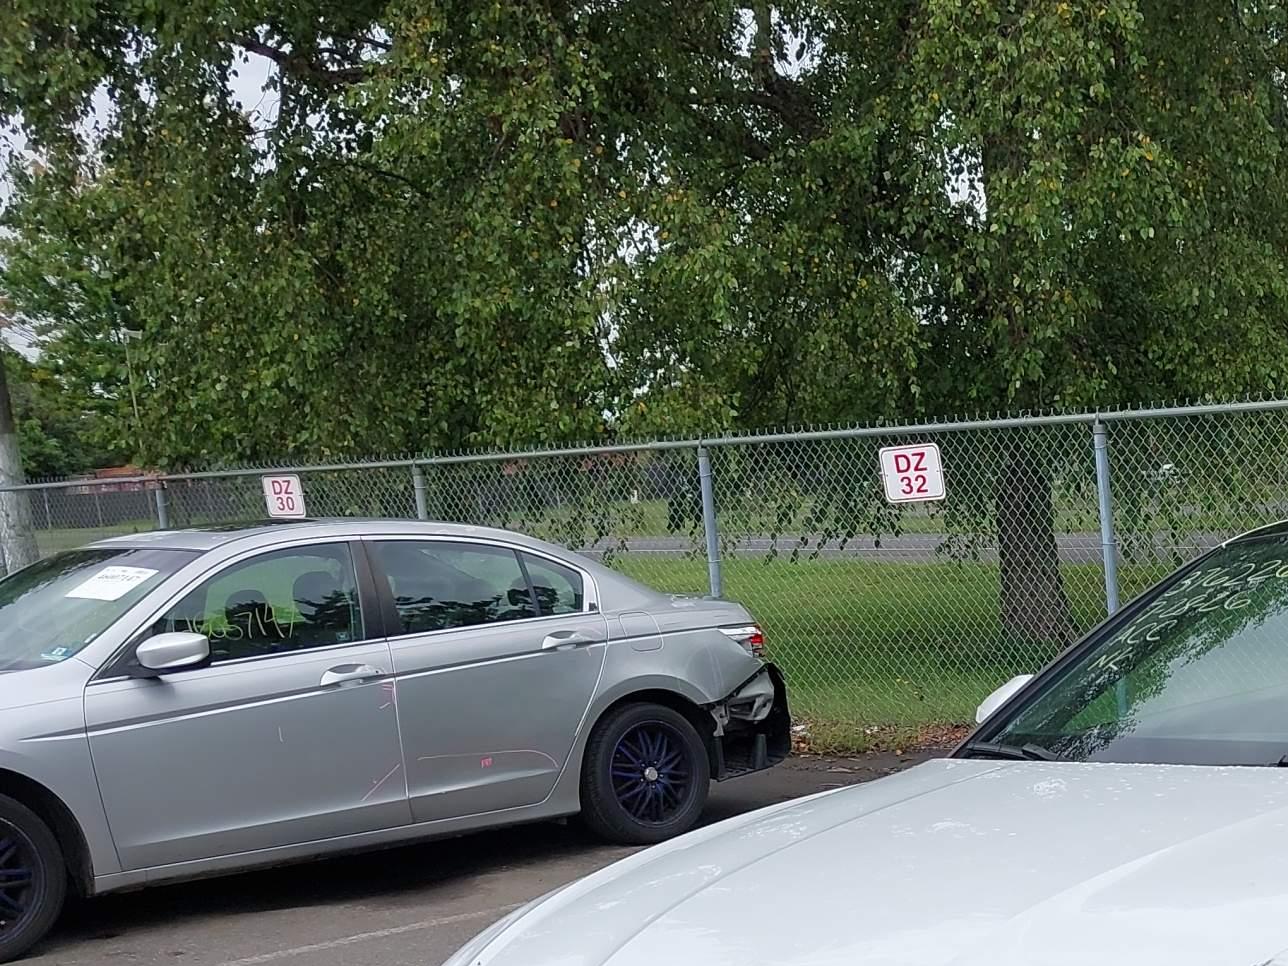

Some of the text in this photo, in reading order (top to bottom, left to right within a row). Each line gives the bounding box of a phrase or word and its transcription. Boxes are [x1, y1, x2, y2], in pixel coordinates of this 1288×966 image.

[894, 451, 928, 474] DZ
[271, 479, 294, 496] DZ
[900, 474, 929, 495] 32
[276, 496, 295, 511] 30
